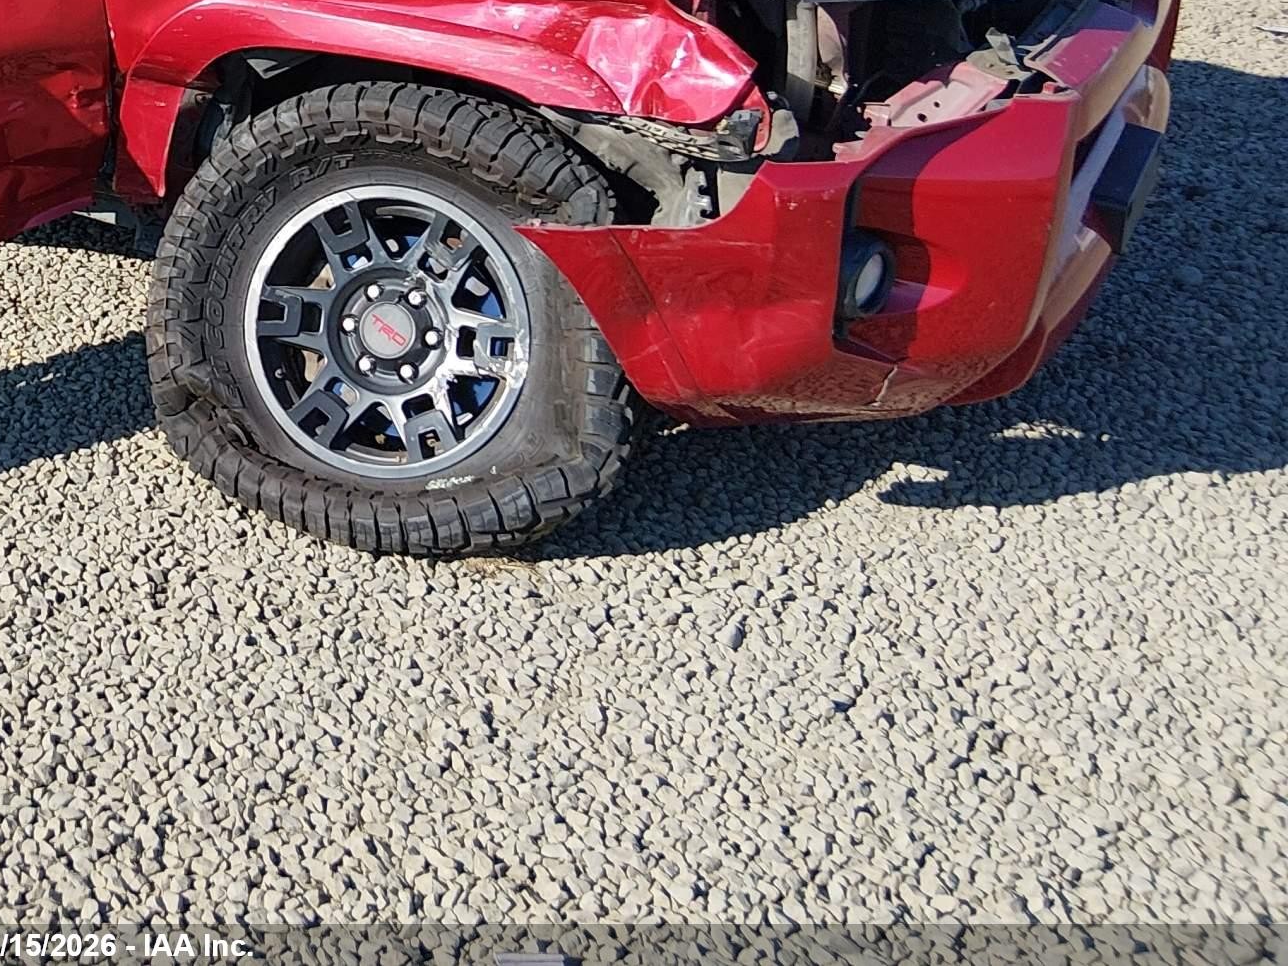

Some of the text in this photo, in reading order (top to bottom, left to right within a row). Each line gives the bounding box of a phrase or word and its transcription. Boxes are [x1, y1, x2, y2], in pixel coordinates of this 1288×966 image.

[205, 185, 278, 351] COUNTRY
[288, 152, 355, 191] R/T
[371, 313, 407, 347] TRD
